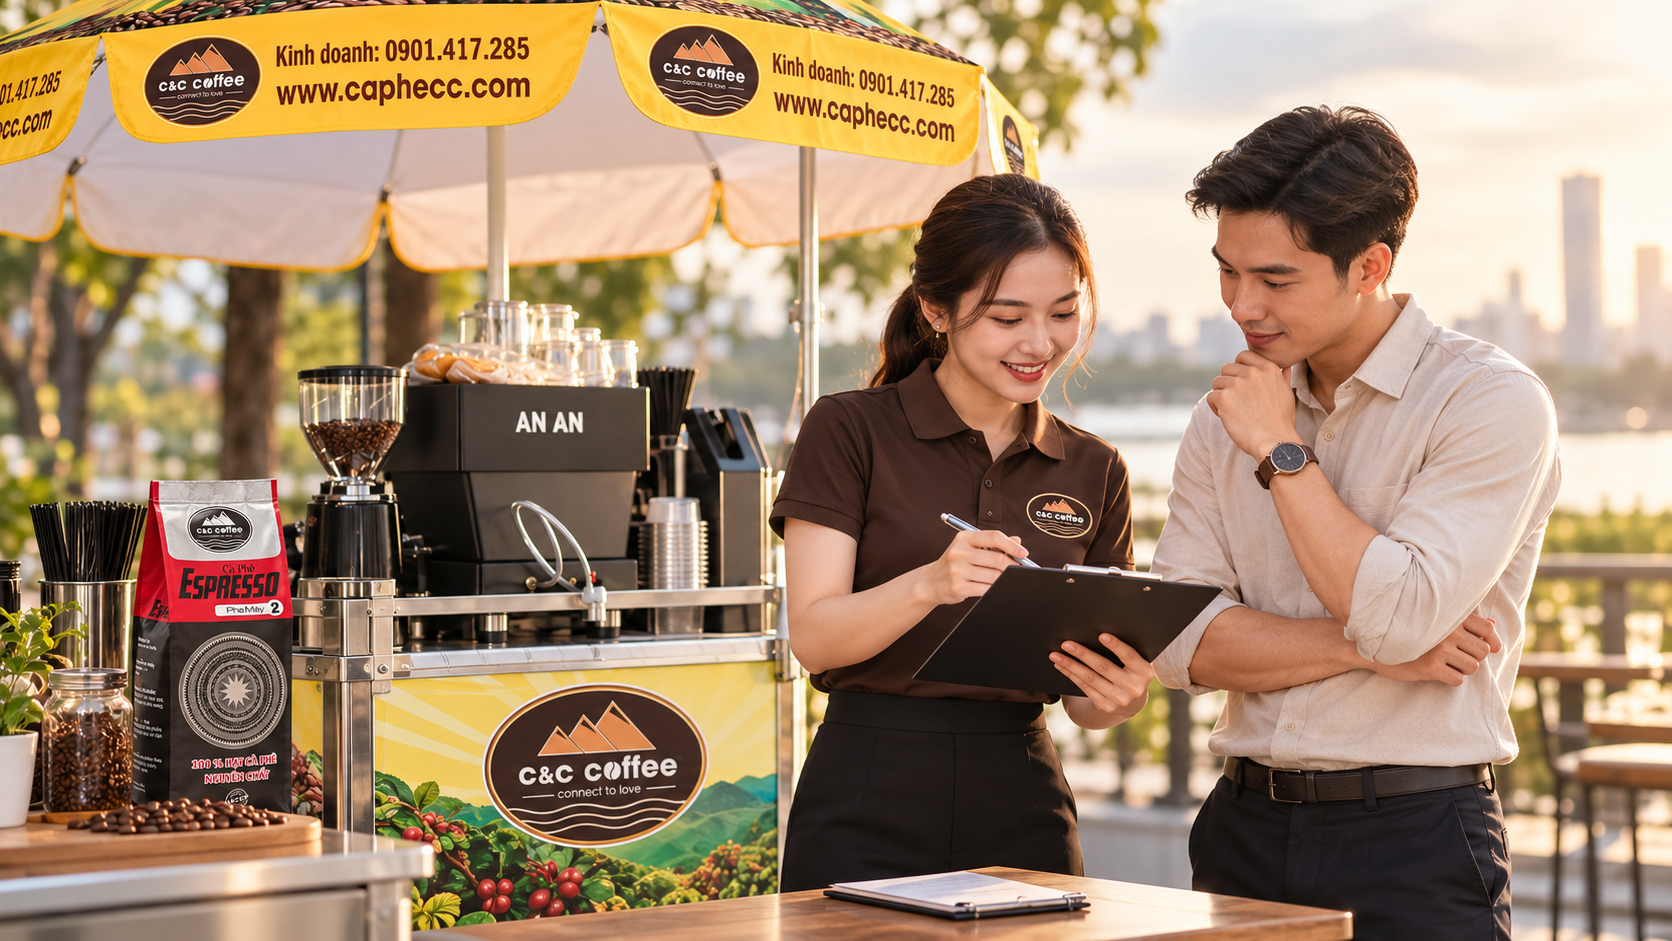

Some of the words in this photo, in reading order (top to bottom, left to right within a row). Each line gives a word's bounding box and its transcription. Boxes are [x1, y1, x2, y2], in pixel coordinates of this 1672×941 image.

[276, 44, 315, 67] Kinh
[320, 41, 380, 64] doanh:
[385, 37, 530, 62] 0901.417.285
[276, 73, 531, 106] www.caphecc.com
[772, 52, 804, 78] Kinh
[808, 60, 855, 88] doanh:
[859, 69, 955, 108] 0901.417.285
[773, 91, 955, 142] www.caphecc.com
[515, 411, 547, 433] AN
[552, 411, 584, 433] AN
[178, 567, 280, 600] ESPRESSO
[270, 602, 280, 613] 2
[191, 758, 211, 769] 100
[557, 785, 602, 799] connect
[605, 786, 617, 796] to
[619, 784, 641, 795] love
